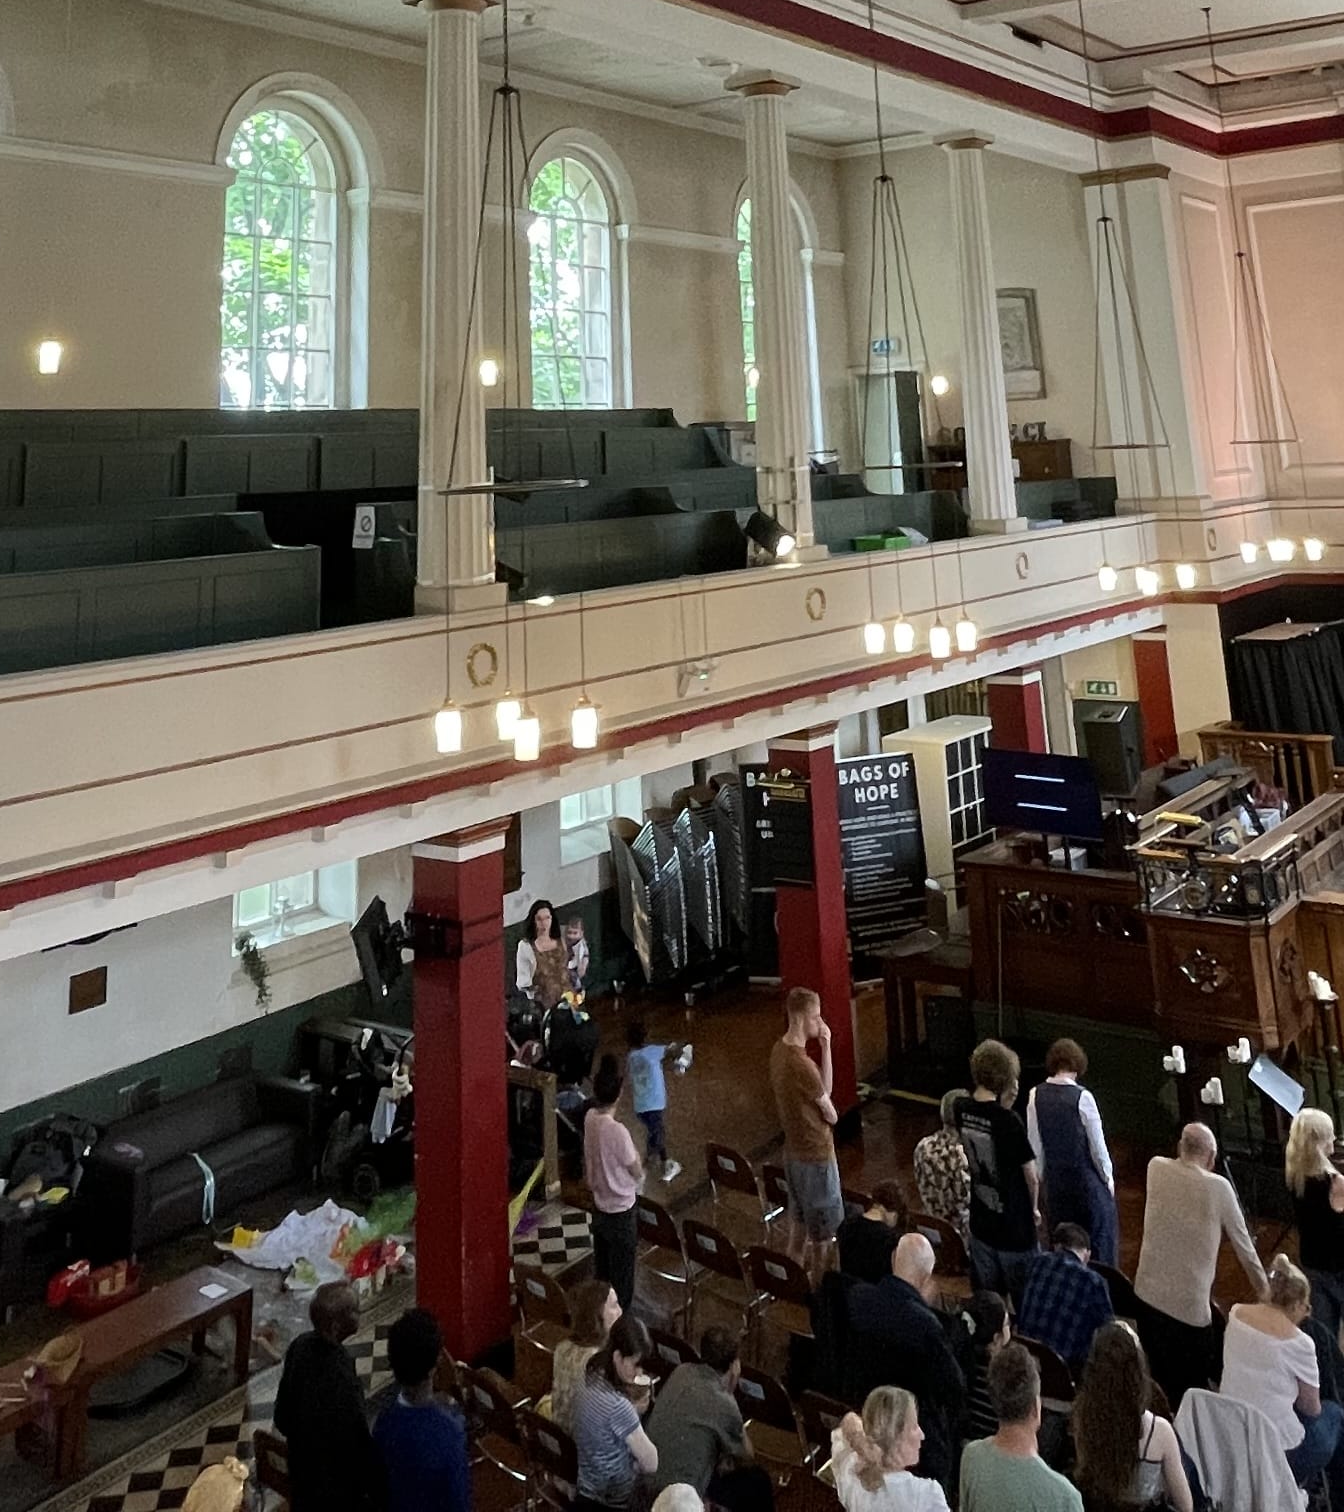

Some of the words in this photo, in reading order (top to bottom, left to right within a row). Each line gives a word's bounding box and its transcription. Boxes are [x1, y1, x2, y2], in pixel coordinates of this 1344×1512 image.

[838, 764, 883, 786] BAGS
[888, 761, 910, 780] OF
[854, 783, 899, 804] HOPE
